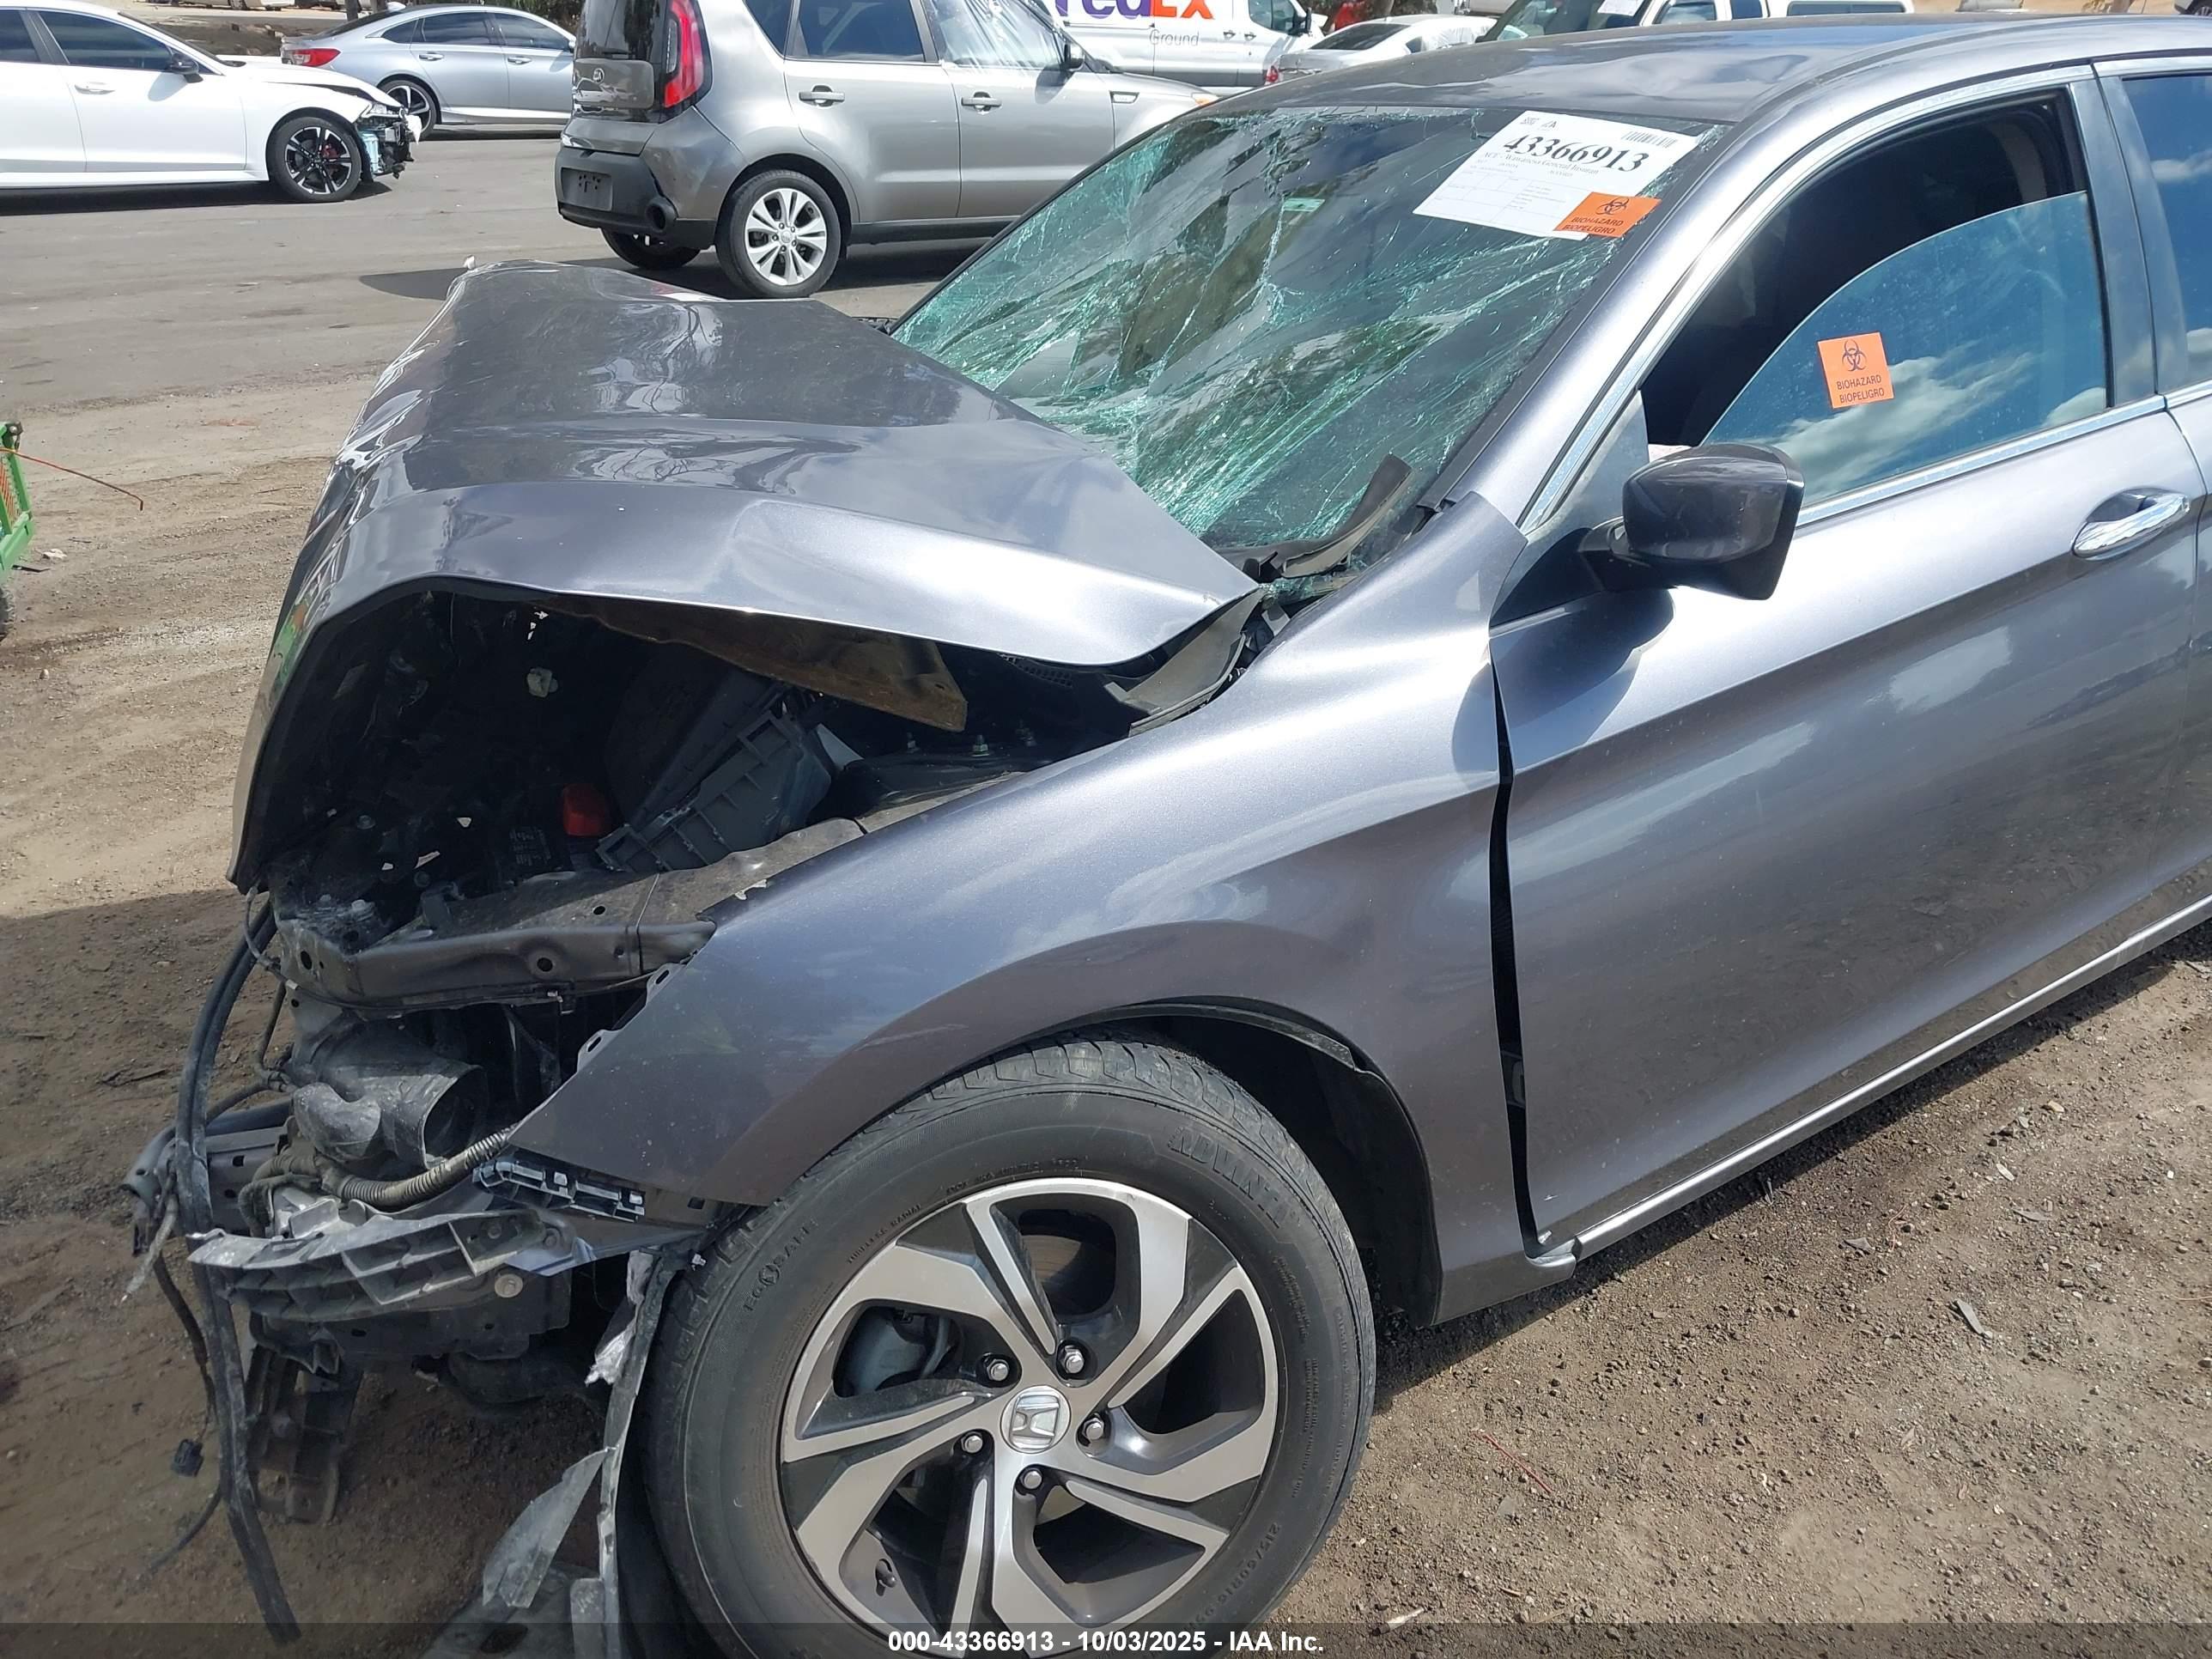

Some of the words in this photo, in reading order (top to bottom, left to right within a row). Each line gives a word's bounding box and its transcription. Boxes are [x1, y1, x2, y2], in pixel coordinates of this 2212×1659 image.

[1149, 29, 1200, 46] Ground
[1504, 135, 1649, 172] 43366913
[1563, 224, 1616, 234] BIOPELIGRO
[1571, 216, 1624, 227] BIOHAZARD
[1836, 374, 1882, 391] BIOHAZARD
[1839, 387, 1885, 404] BIOPELIGRO
